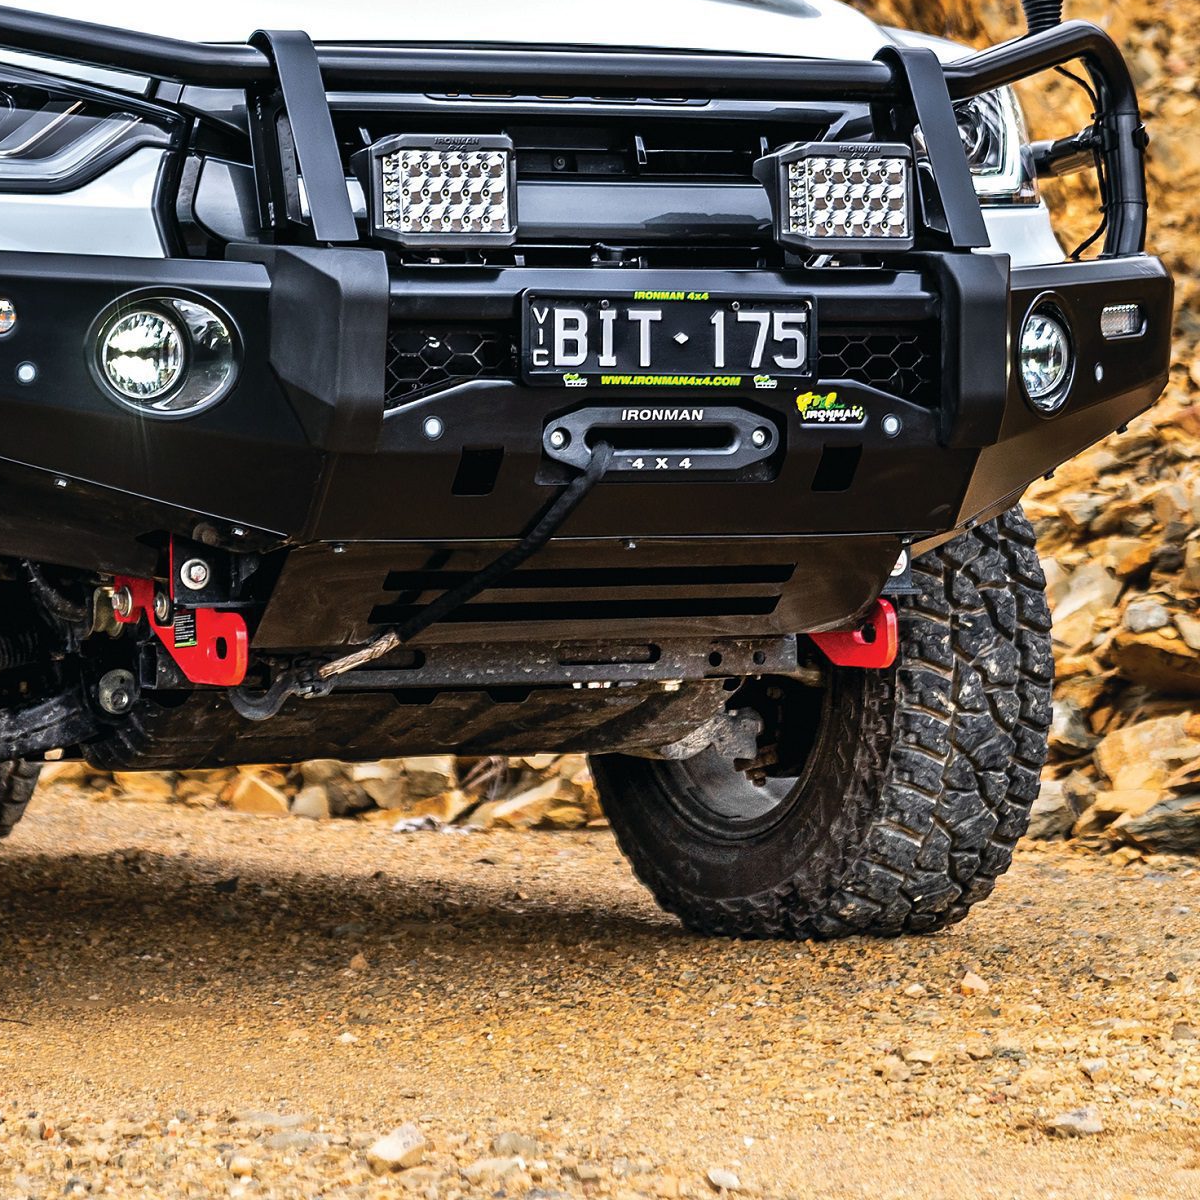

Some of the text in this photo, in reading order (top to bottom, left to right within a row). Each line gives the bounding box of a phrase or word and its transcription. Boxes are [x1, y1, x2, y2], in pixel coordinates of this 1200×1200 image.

[634, 291, 685, 301] IRONMAN
[533, 307, 549, 366] VIC
[554, 308, 807, 369] BIT 175
[621, 409, 704, 421] IRONMAN
[805, 409, 861, 419] IRONMAN
